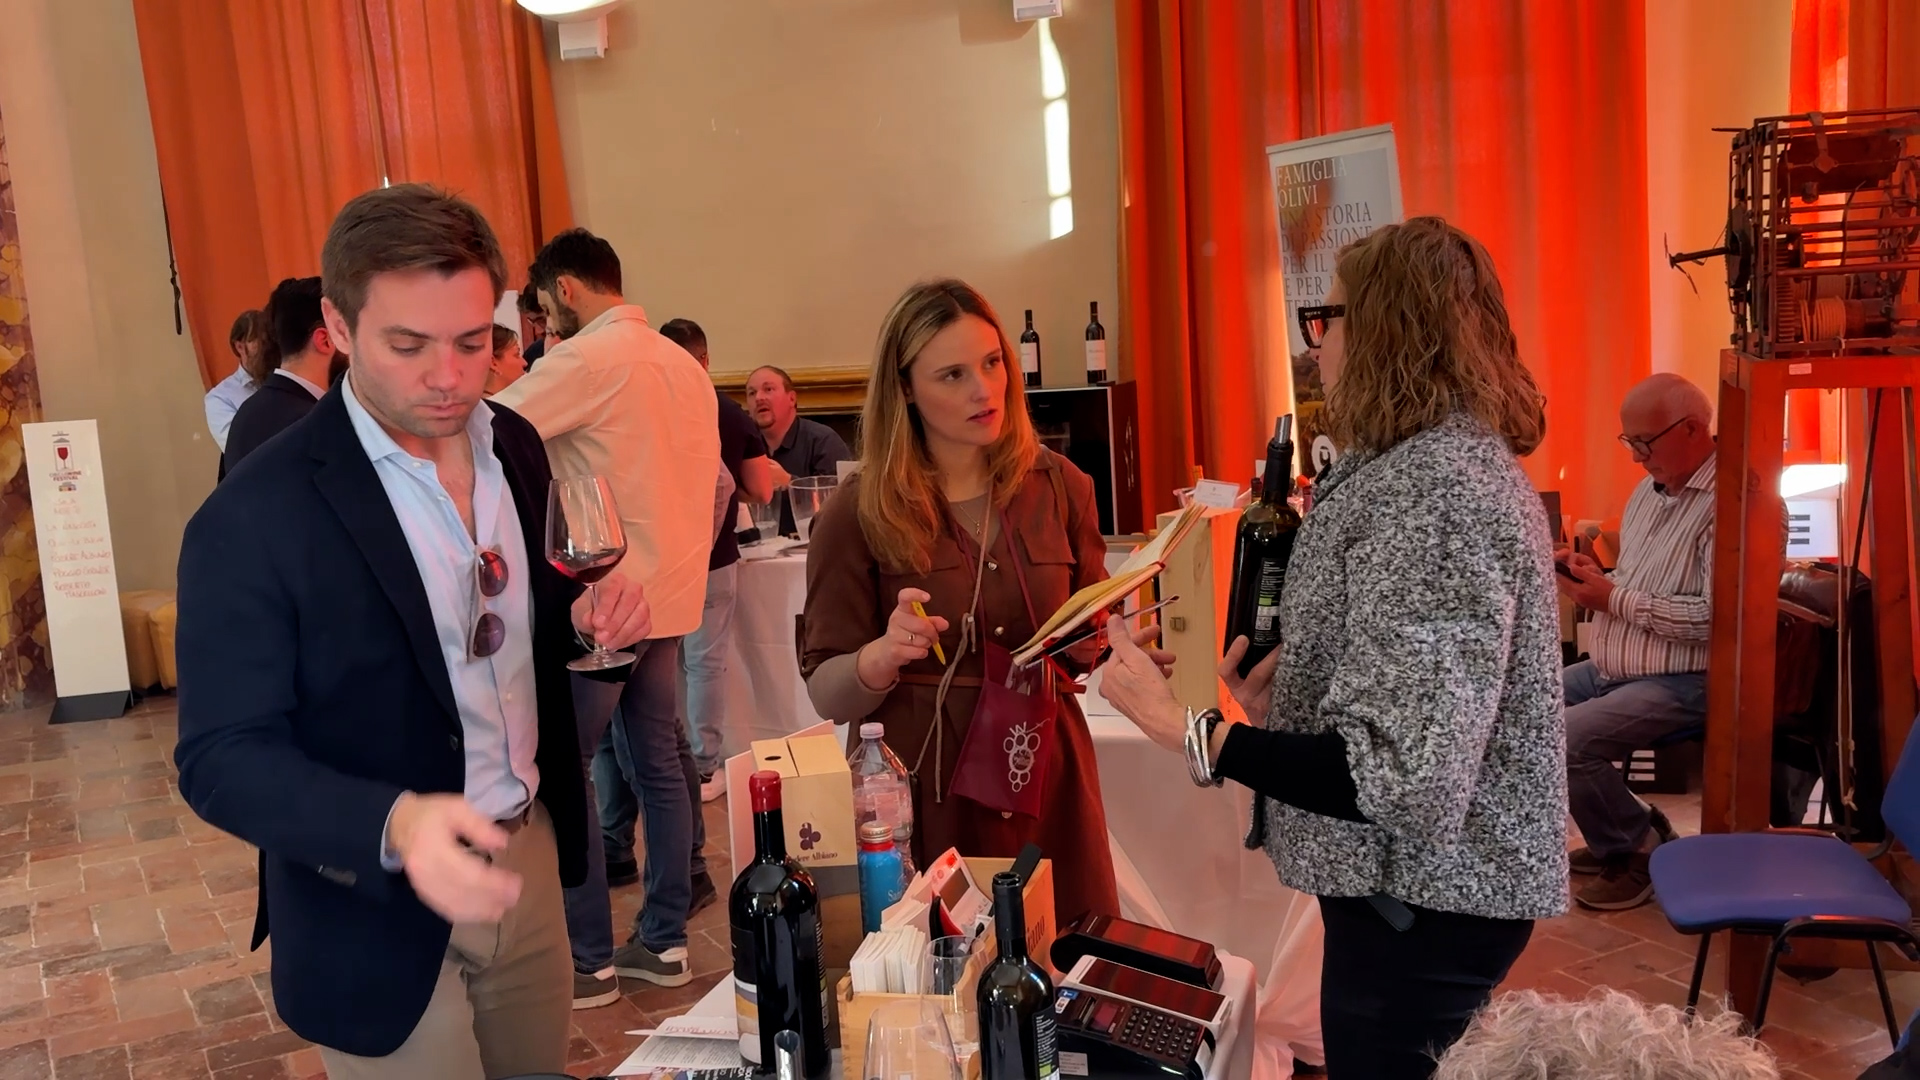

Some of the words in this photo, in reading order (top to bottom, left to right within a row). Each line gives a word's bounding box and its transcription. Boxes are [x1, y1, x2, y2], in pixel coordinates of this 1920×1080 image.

[1276, 157, 1347, 186] FAMIGLIA
[1278, 185, 1318, 208] OLIVI
[1280, 209, 1310, 231] UNA
[1315, 201, 1372, 227] STORIA
[1281, 233, 1295, 253] DI
[1283, 254, 1308, 275] PER
[1314, 253, 1328, 273] IL
[1285, 278, 1292, 296] E
[1297, 276, 1324, 296] PER
